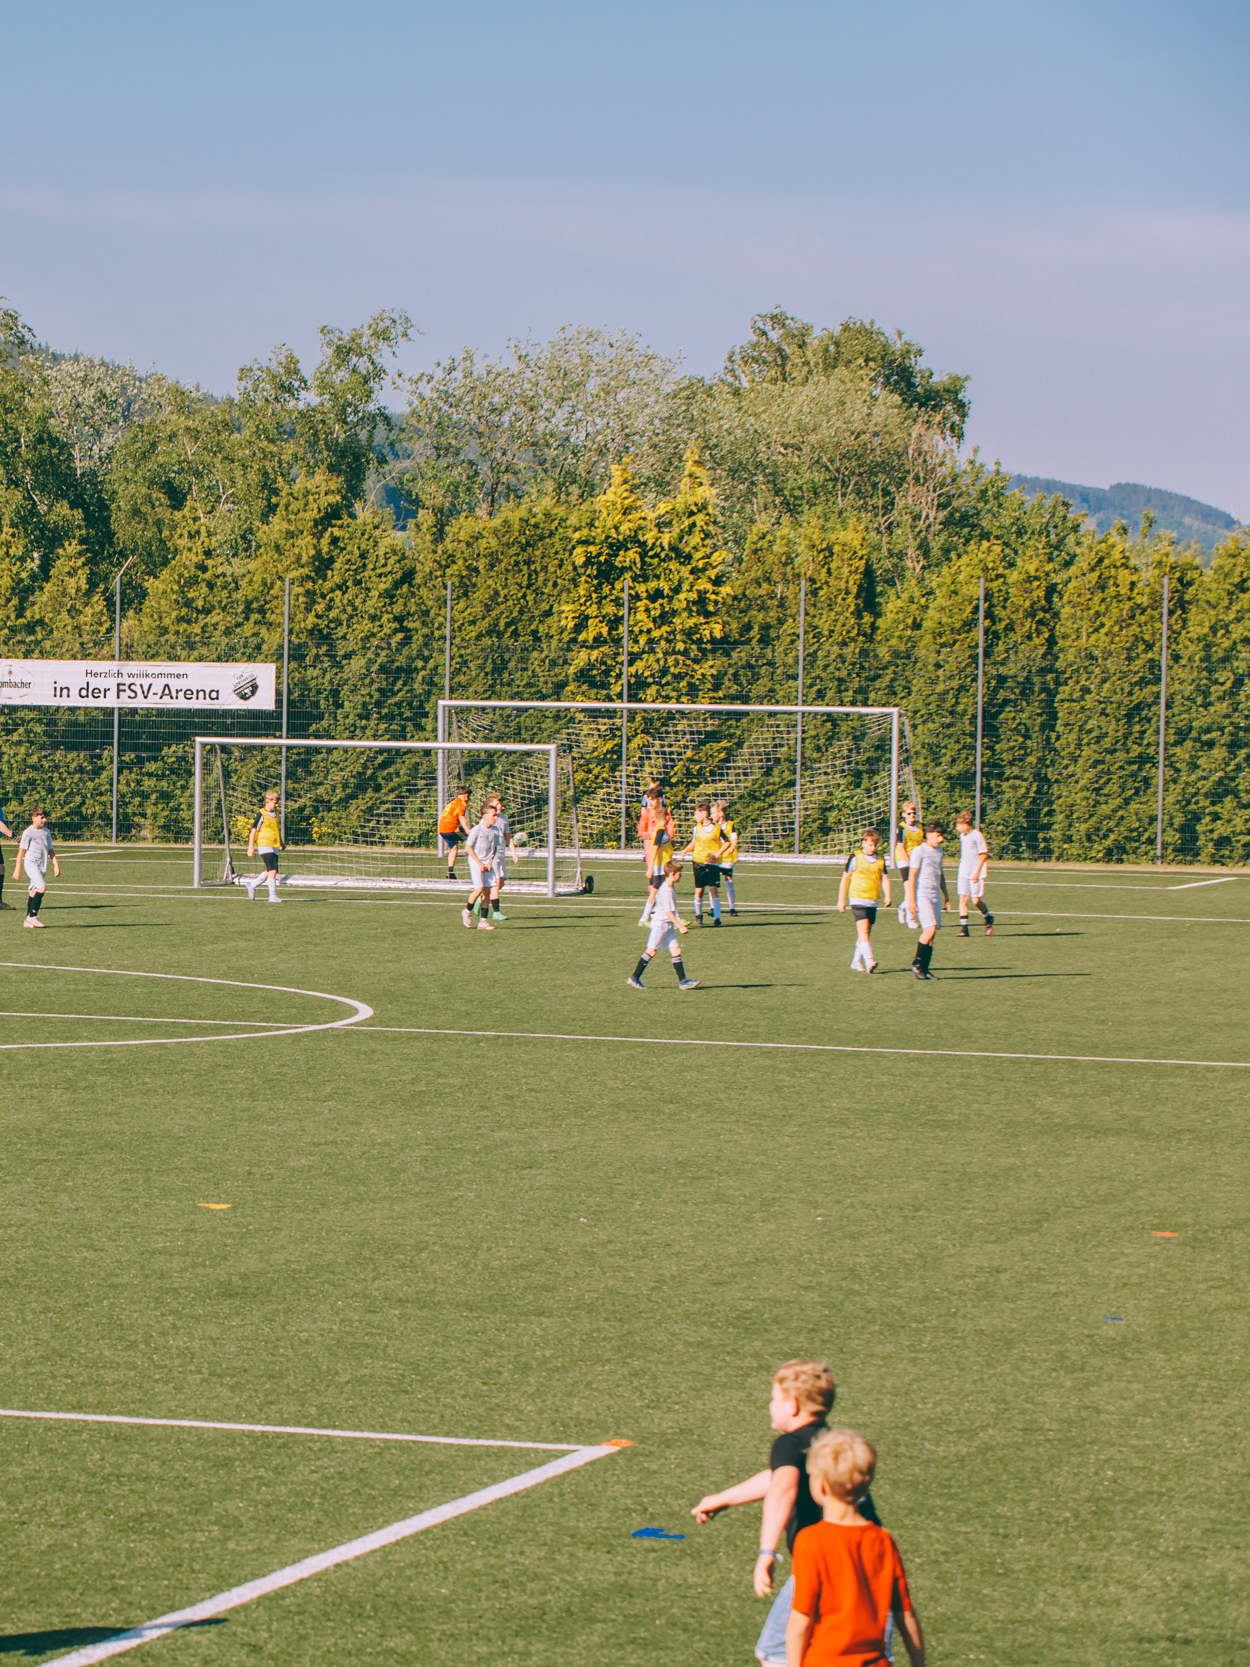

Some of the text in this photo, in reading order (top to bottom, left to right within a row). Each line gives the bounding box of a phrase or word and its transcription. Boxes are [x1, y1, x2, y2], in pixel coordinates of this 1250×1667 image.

[85, 669, 189, 680] Herzlich willkommen
[53, 681, 220, 701] in der FSV-Arena
